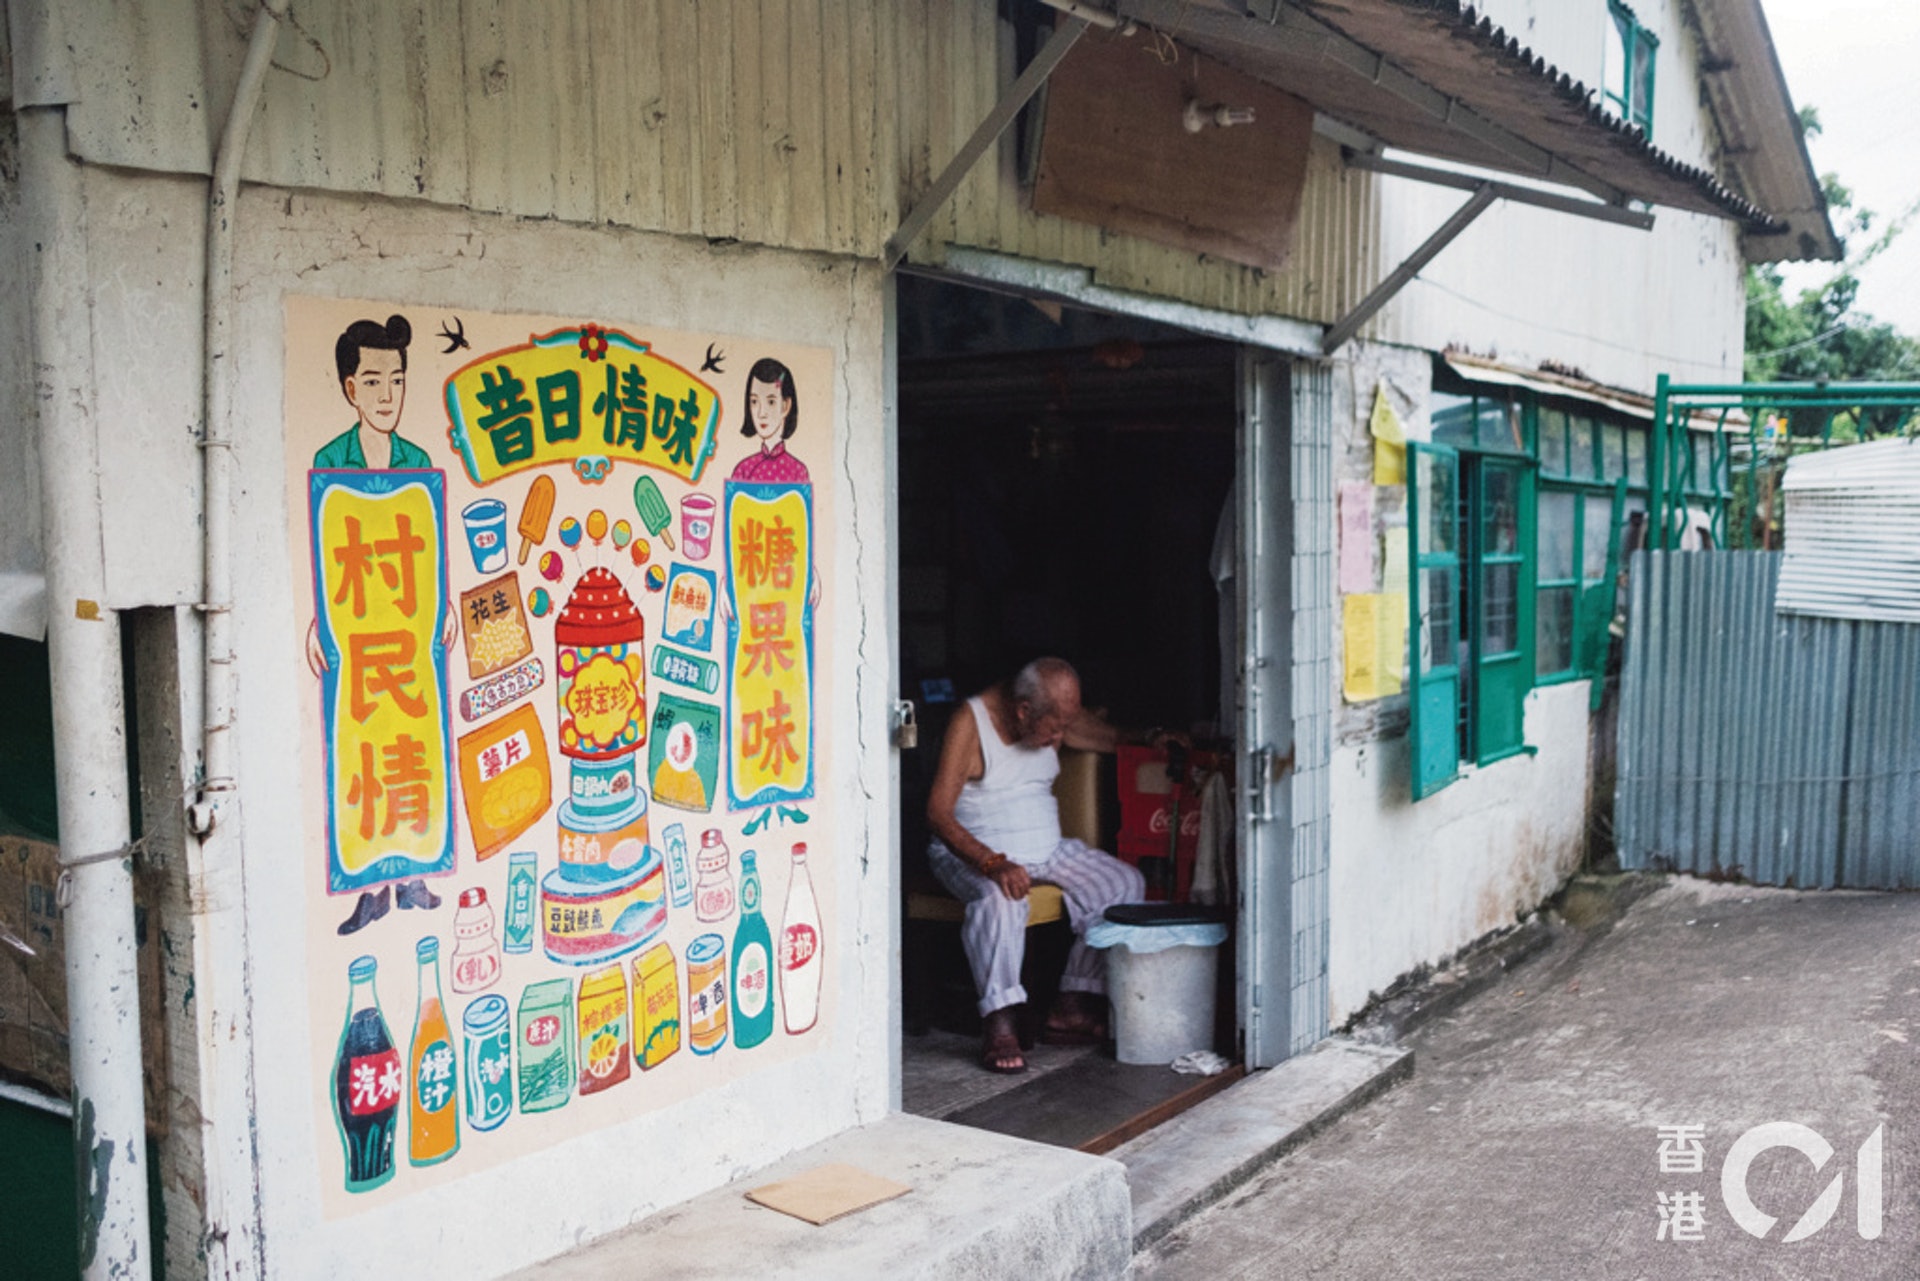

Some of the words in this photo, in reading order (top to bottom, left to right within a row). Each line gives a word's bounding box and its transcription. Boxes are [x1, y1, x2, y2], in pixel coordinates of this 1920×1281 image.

[475, 364, 700, 467] 昔日情味
[470, 590, 511, 625] 花生
[738, 515, 799, 777] 糖果味
[333, 514, 428, 841] 村民情
[483, 738, 522, 779] 薯片
[550, 907, 604, 933] 豆豉鯪魚
[691, 980, 725, 1016] 啤酒
[353, 1061, 402, 1108] 汽水
[419, 1046, 455, 1111] 橙汁
